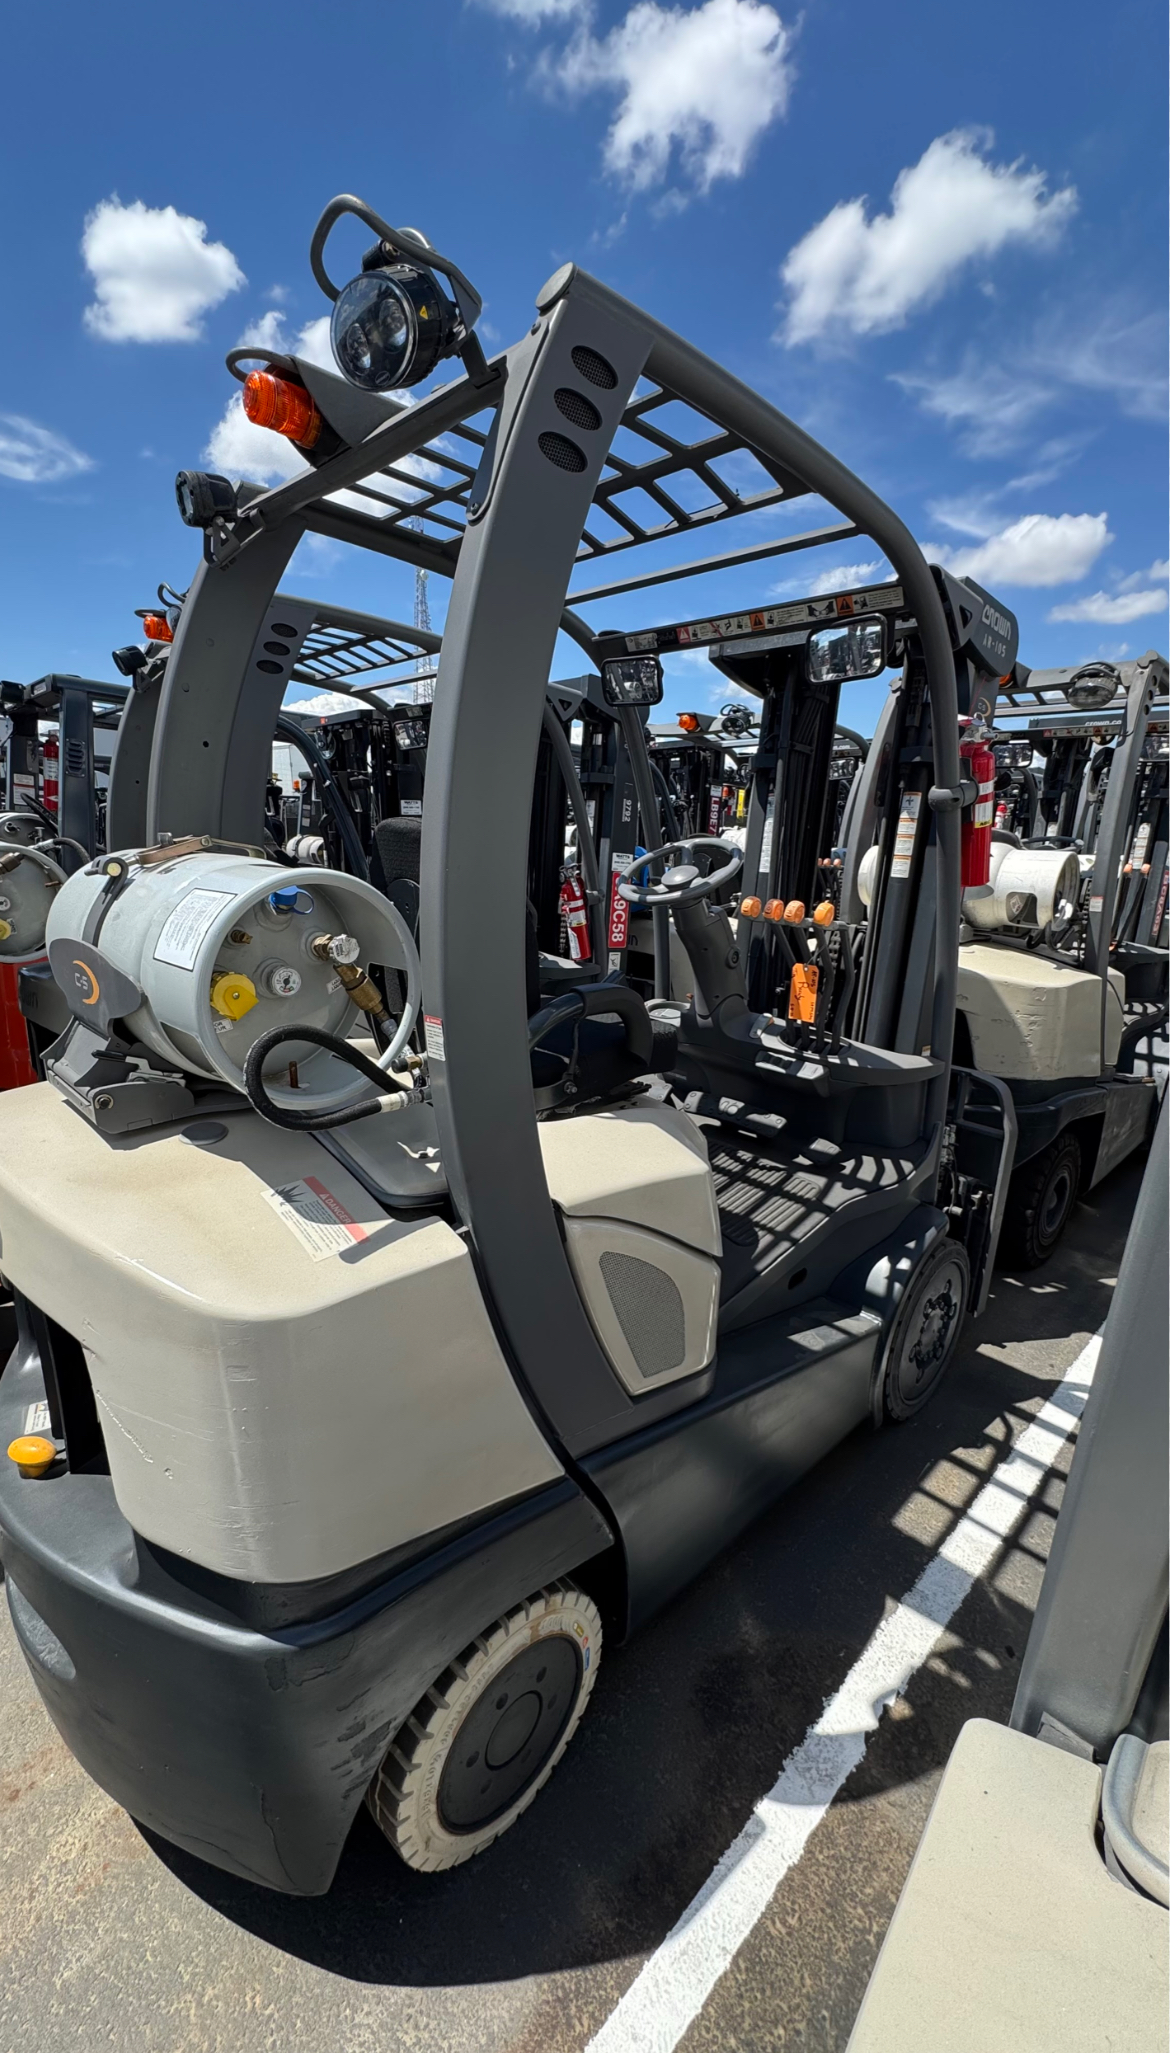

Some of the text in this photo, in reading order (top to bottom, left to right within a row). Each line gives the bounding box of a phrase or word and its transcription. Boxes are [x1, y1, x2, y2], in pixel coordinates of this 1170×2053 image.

[982, 633, 1007, 658] AR-105
[709, 797, 720, 836] LB9E7
[325, 1198, 351, 1223] DANGER
